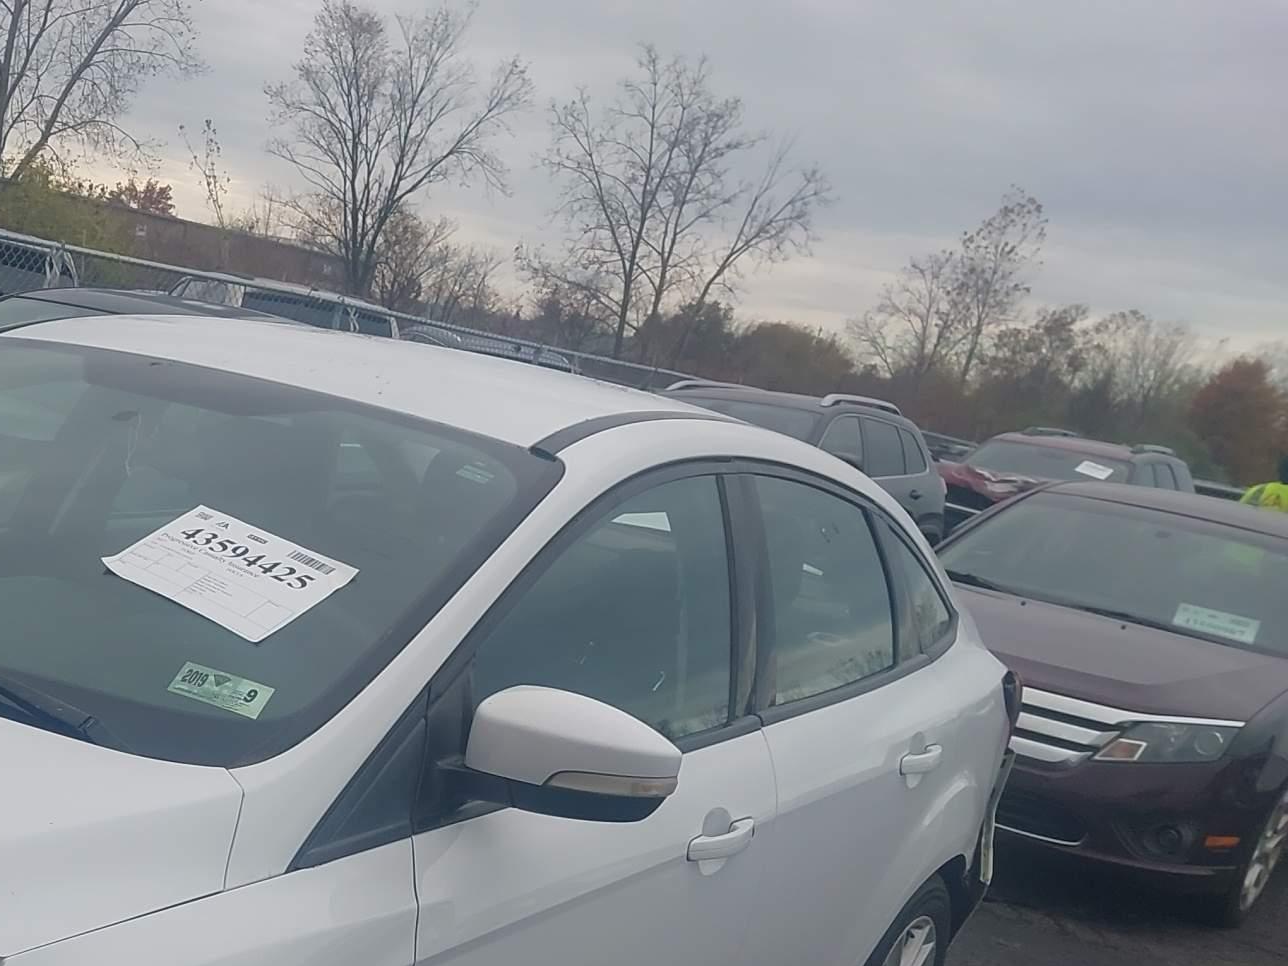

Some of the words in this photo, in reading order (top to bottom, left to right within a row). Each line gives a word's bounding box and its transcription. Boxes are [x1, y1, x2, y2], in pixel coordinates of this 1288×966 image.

[180, 528, 317, 590] 43594425
[181, 668, 210, 688] 2019
[243, 689, 259, 703] 9
